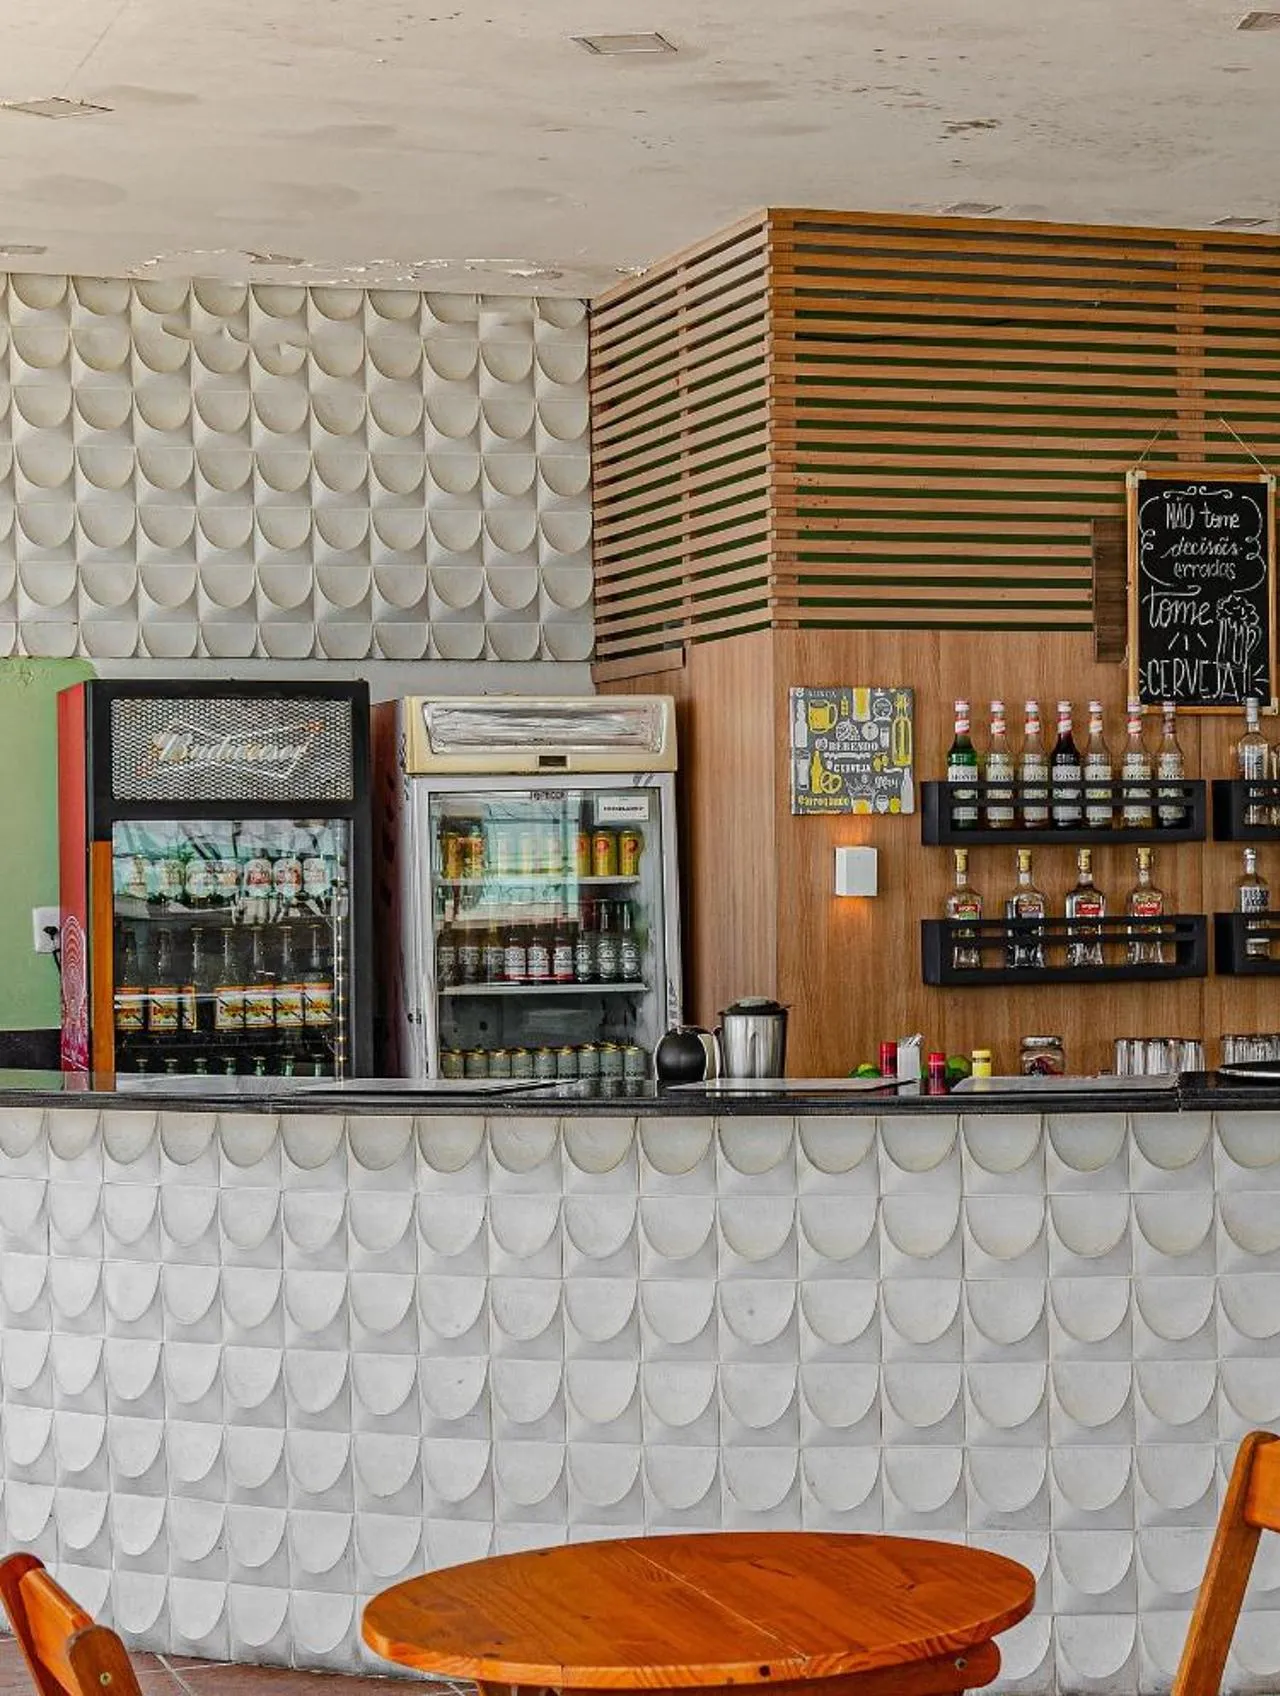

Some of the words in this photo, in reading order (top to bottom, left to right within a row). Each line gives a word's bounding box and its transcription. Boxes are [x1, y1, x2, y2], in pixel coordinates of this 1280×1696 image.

[1166, 497, 1194, 530] NÃO
[1200, 501, 1240, 529] tome
[1173, 560, 1236, 579] erradas
[1142, 585, 1214, 628] tome
[1148, 658, 1240, 702] CERVEJA
